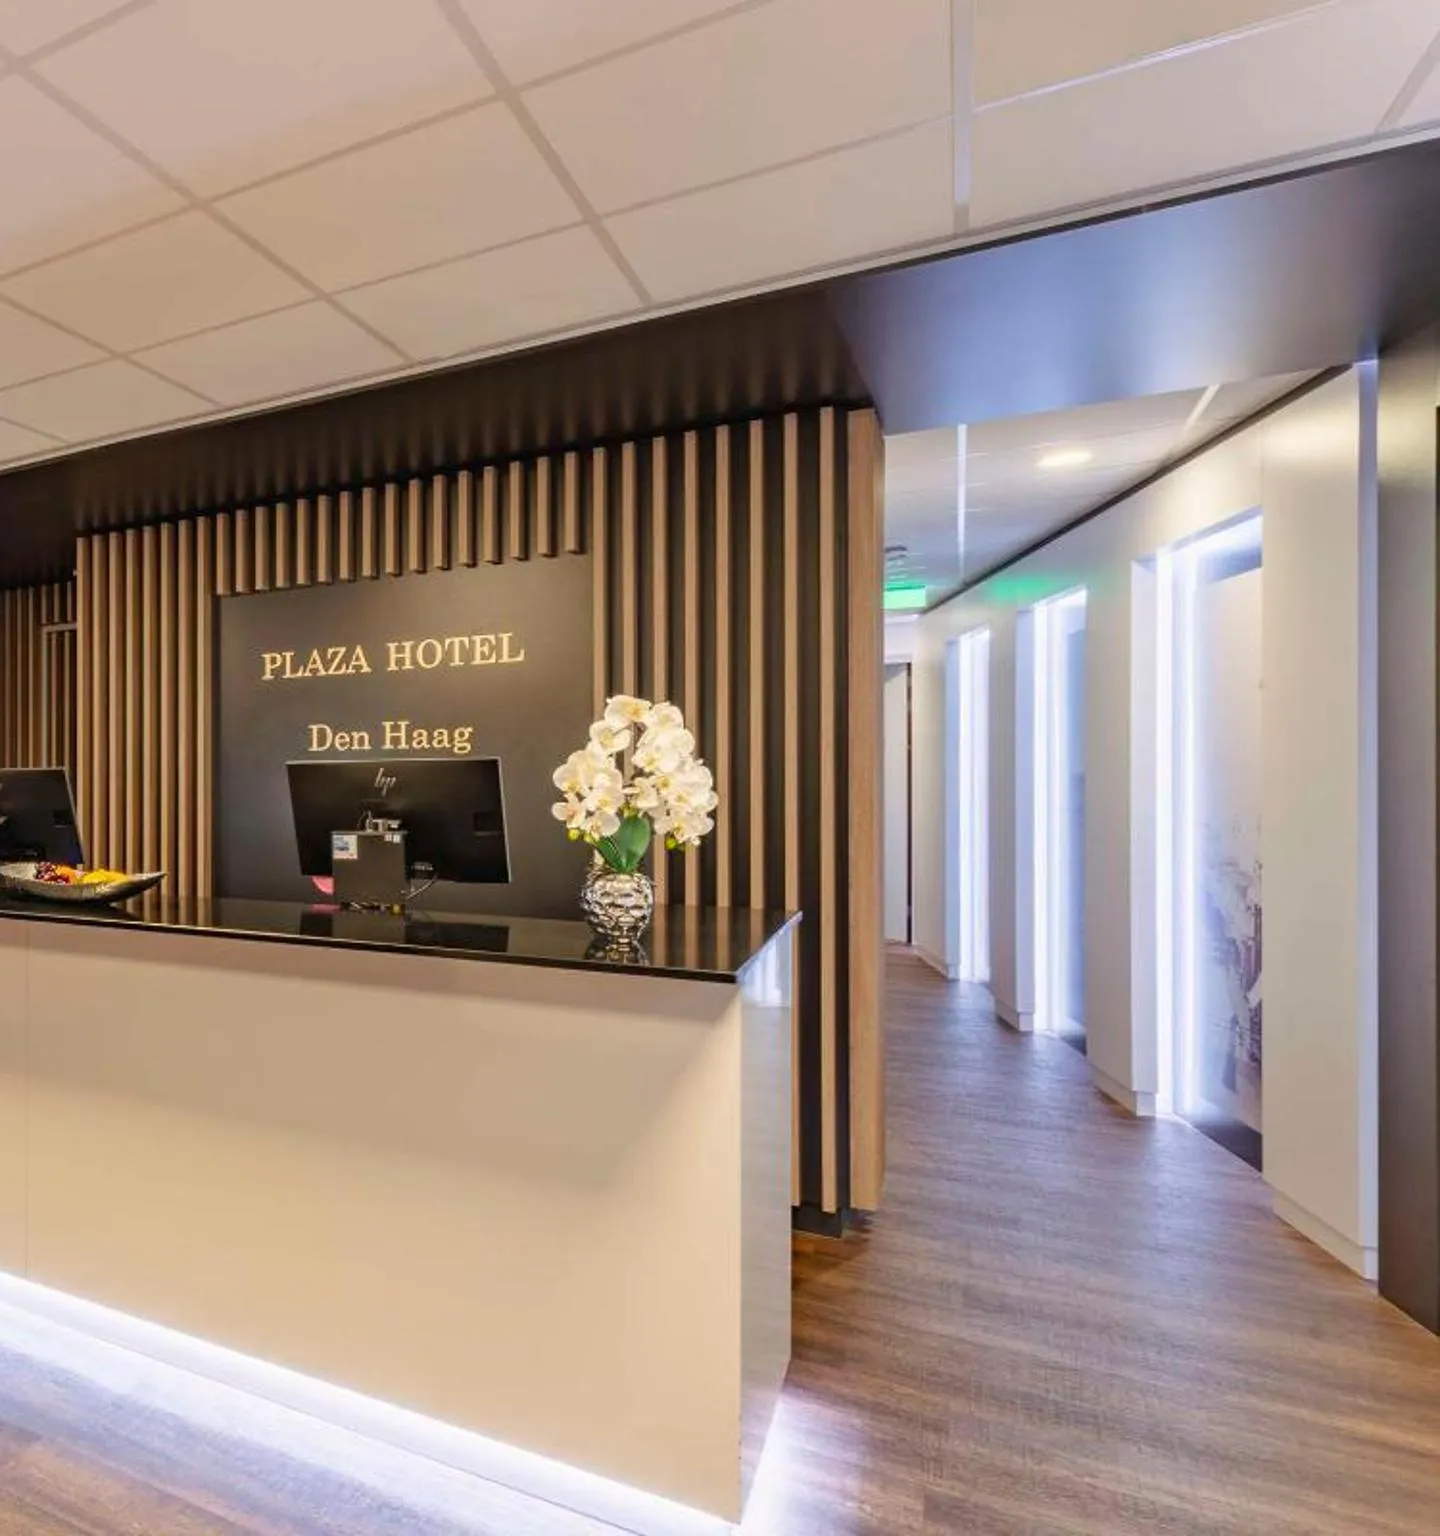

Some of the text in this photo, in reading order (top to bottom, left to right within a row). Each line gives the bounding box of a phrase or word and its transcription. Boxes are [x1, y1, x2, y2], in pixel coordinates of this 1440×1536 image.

[261, 633, 525, 680] PLAZA HOTEL
[308, 721, 473, 754] Den Haag
[374, 767, 396, 797] hp
